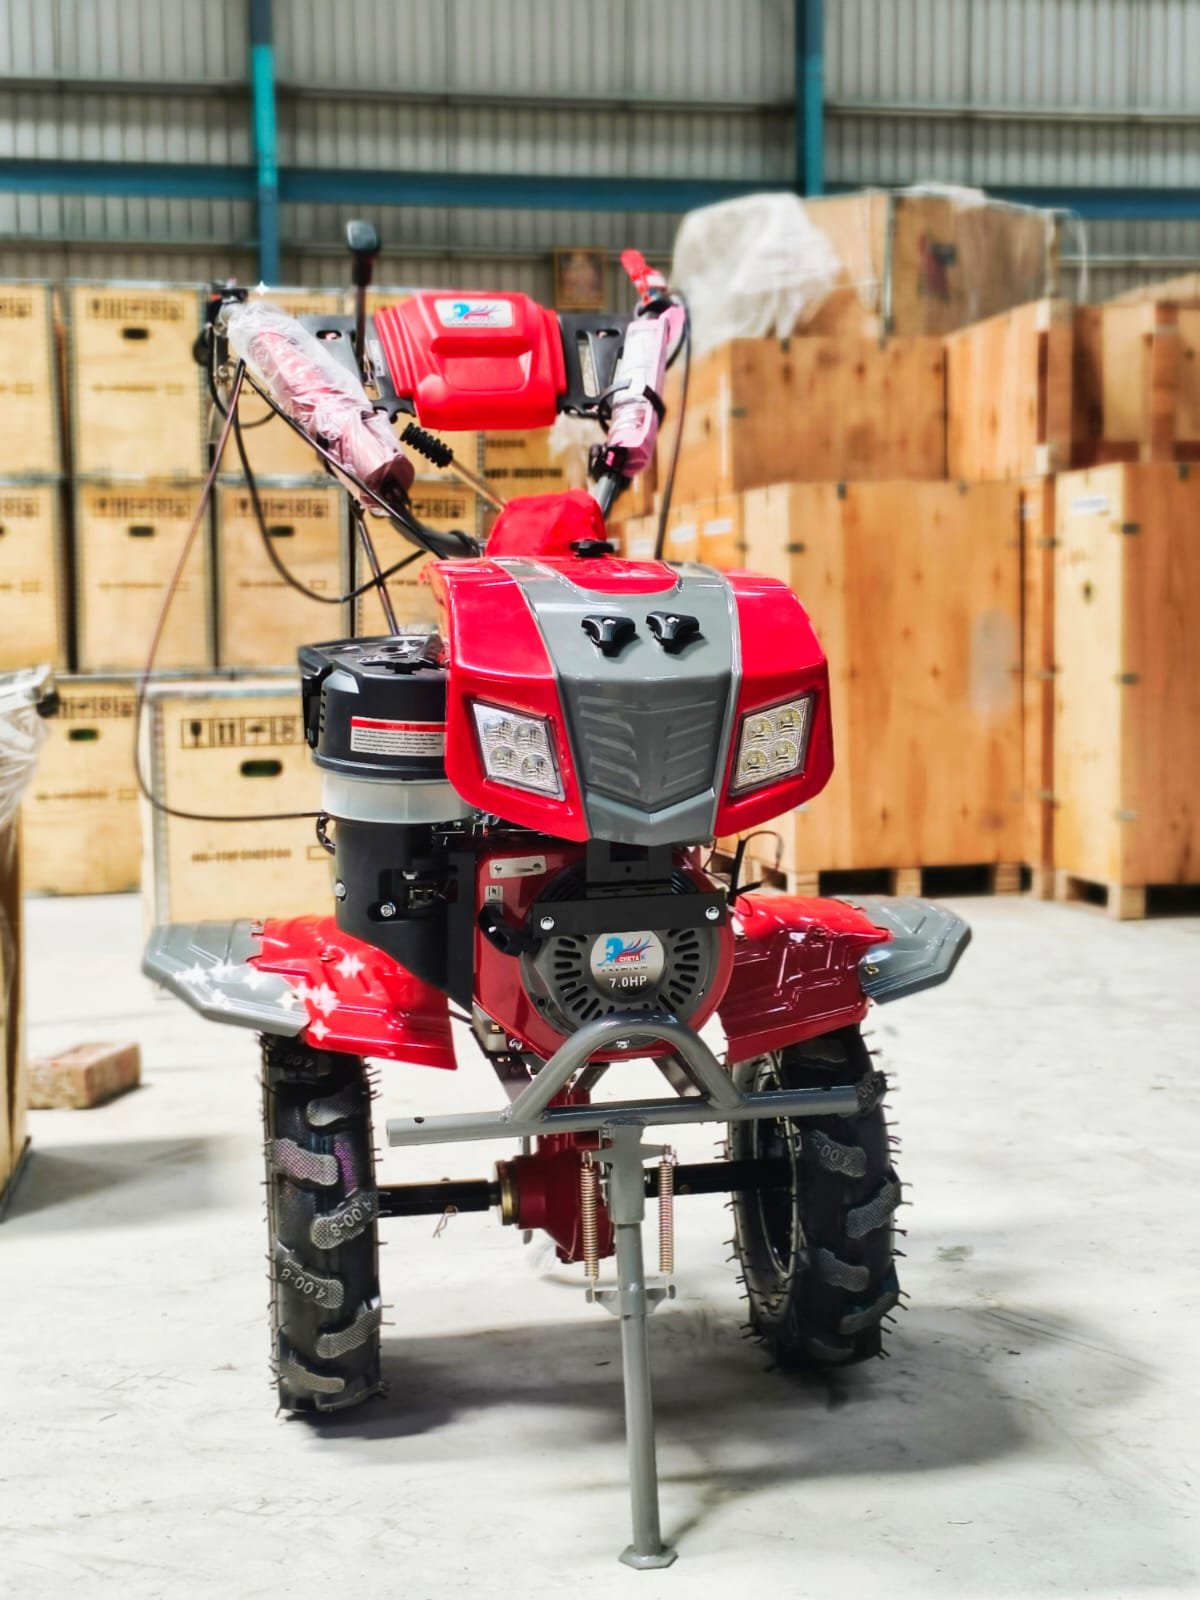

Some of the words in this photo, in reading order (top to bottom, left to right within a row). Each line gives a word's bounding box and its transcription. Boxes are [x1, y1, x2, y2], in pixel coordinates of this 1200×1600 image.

[609, 975, 648, 989] 7.0HP
[329, 1197, 373, 1237] 4.00-8
[280, 1267, 327, 1300] 4.00-8
